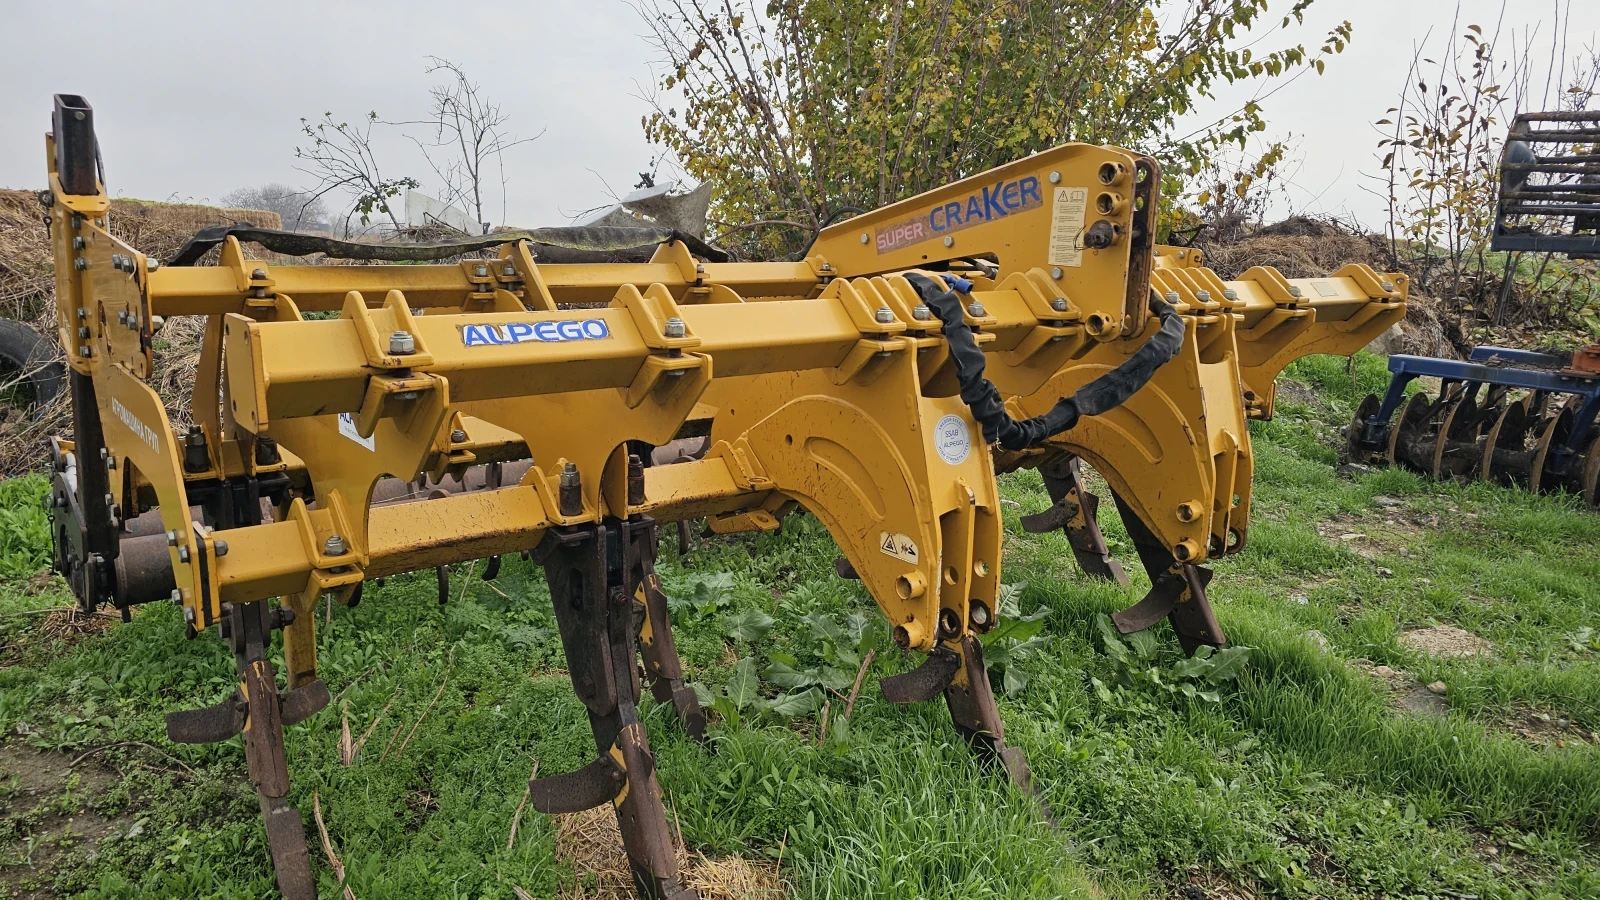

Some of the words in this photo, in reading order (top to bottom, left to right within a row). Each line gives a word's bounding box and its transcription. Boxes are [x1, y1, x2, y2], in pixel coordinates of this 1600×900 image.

[876, 222, 924, 250] SUPER
[929, 176, 1041, 232] CRAKER
[465, 319, 609, 347] ALPEGO
[945, 429, 958, 438] SSAB
[943, 440, 964, 448] ALPEGO
